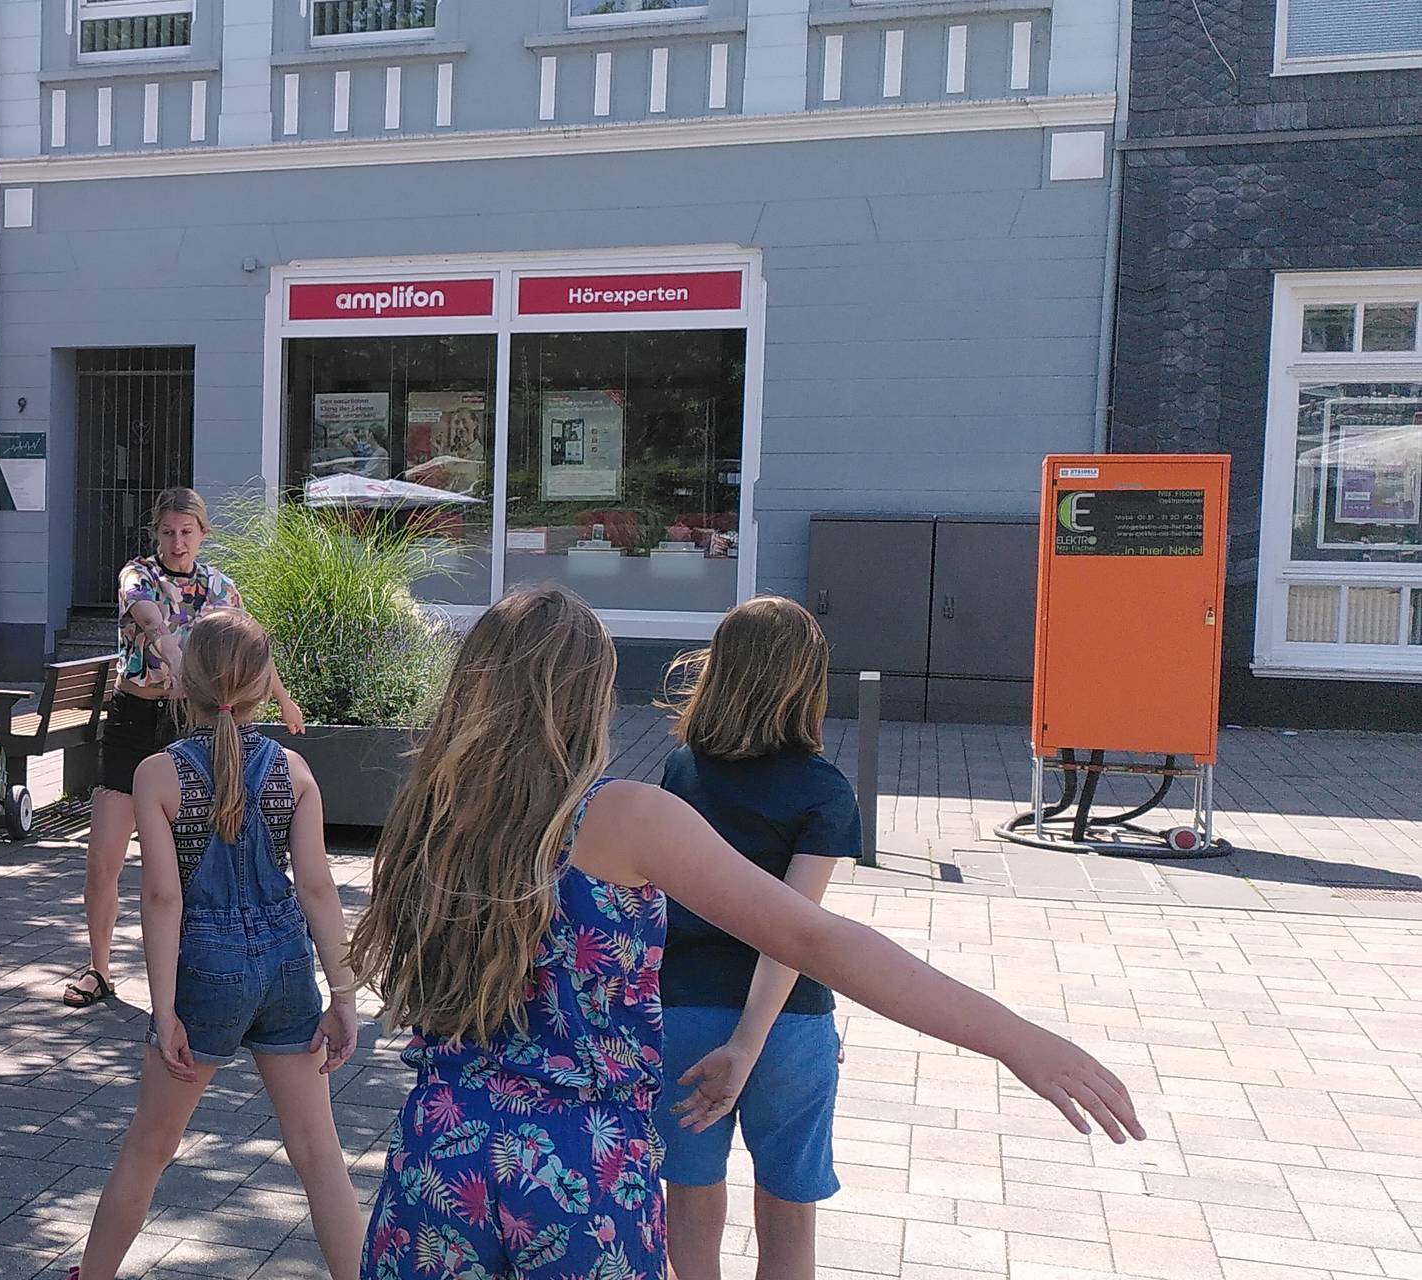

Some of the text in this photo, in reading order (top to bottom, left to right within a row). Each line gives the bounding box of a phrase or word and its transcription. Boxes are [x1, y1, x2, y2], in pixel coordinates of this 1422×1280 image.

[336, 285, 445, 314] amplifon
[568, 287, 689, 307] Hörexperten
[18, 397, 27, 414] 9
